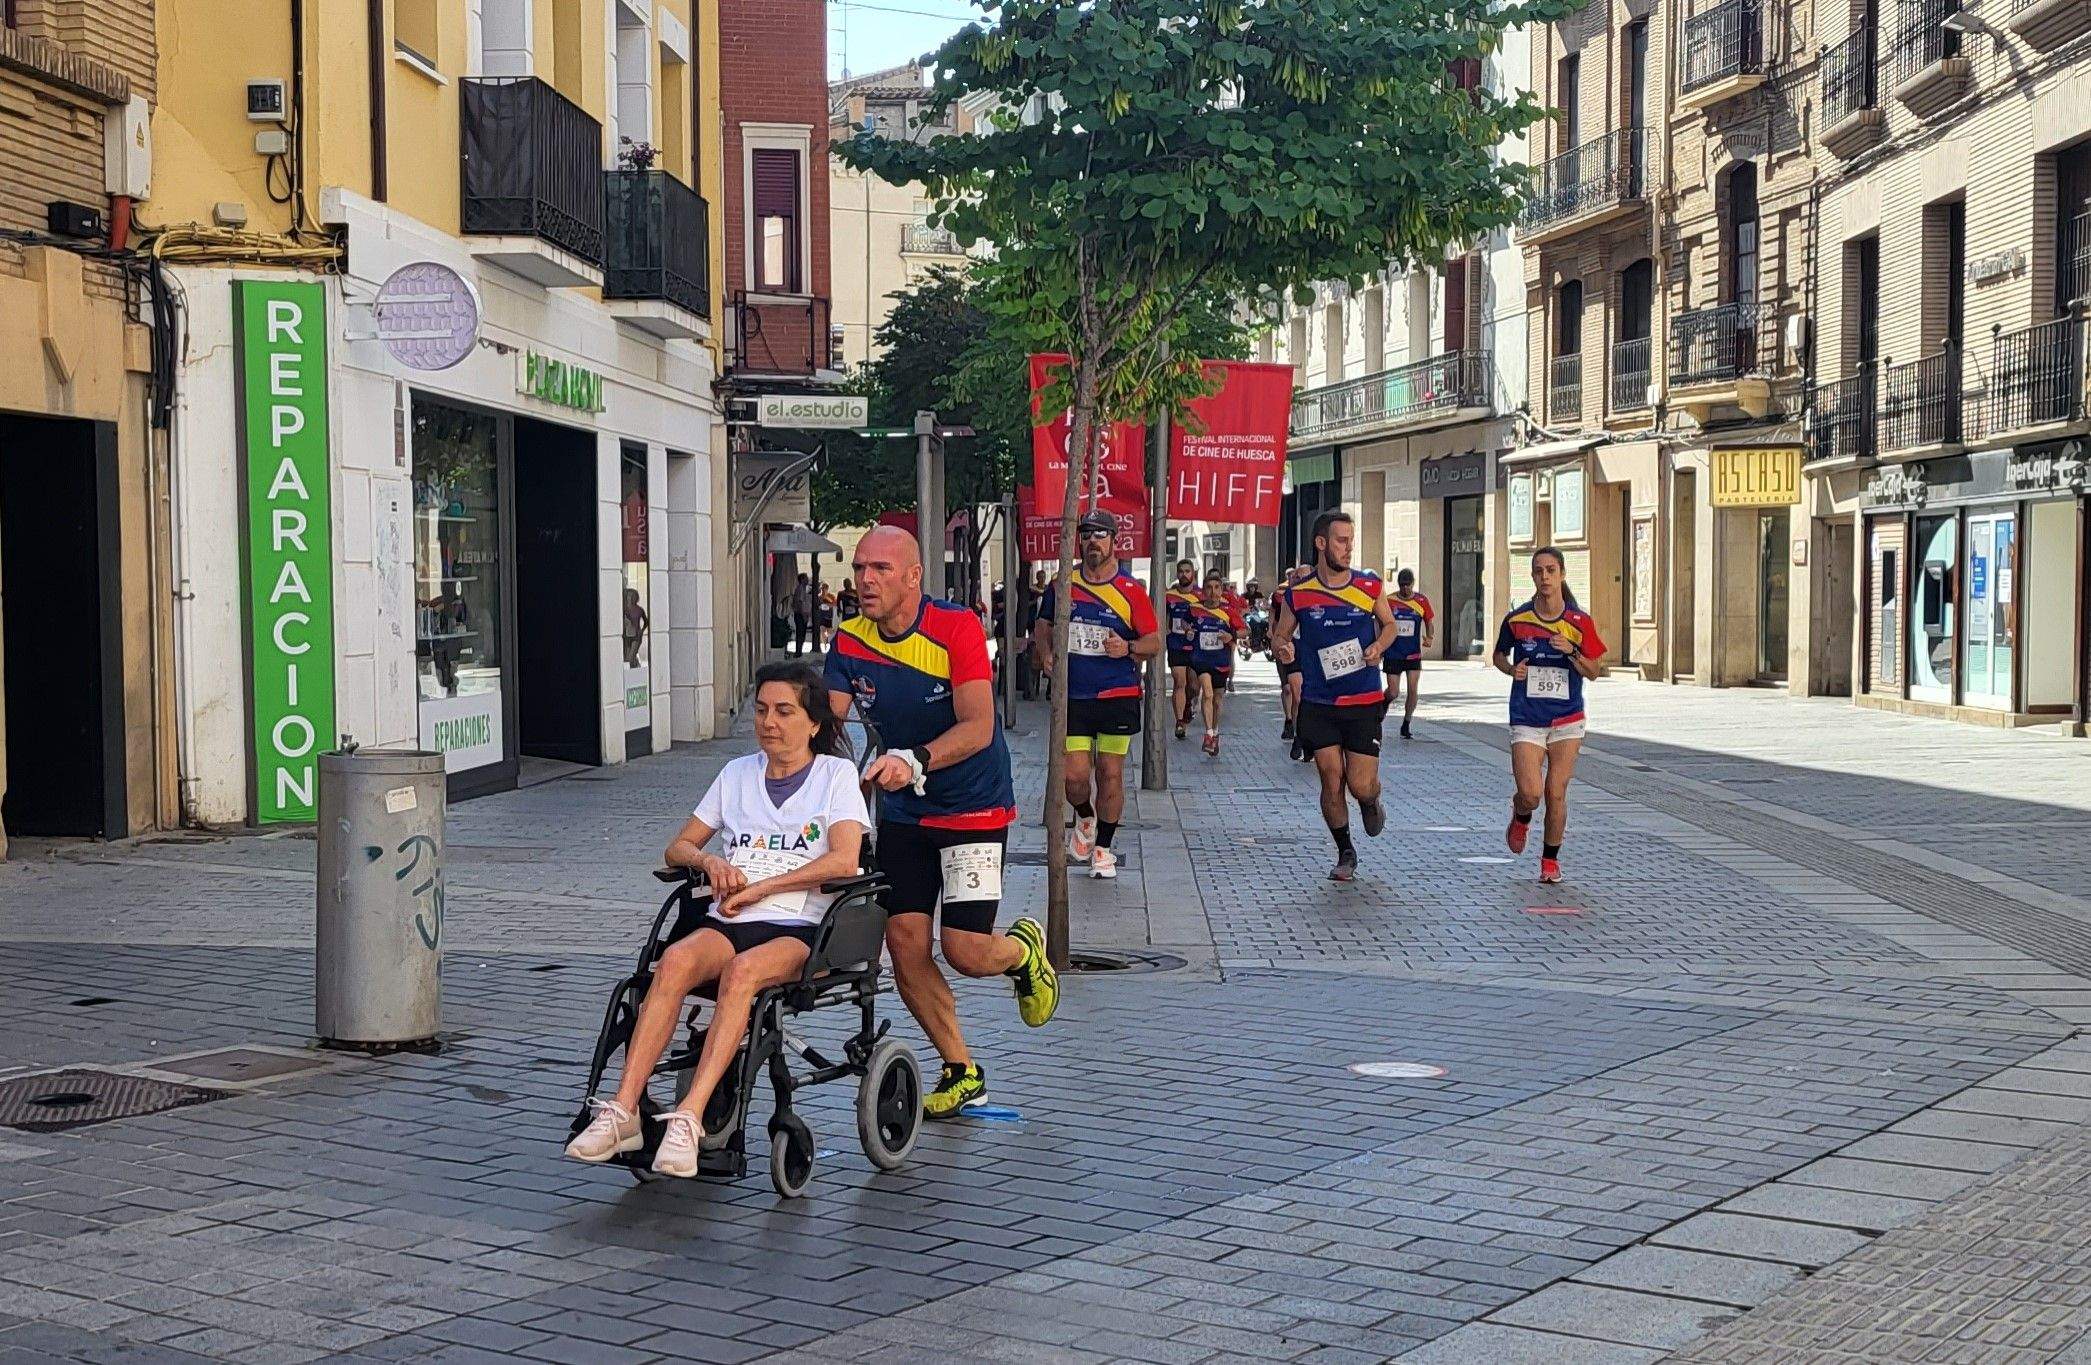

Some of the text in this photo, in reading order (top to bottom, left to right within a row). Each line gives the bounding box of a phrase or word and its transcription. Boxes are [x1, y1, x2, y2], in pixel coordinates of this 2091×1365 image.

[767, 399, 863, 418] el.estudio
[1183, 435, 1276, 444] FESTIVAL INTERNACIONAL
[1183, 446, 1276, 461] DE CINE DE HUESCA
[1718, 452, 1794, 493] ASCASO
[1179, 470, 1275, 509] HIFF
[267, 300, 315, 808] REPARACION
[1076, 639, 1100, 650] 129
[1332, 656, 1357, 671] 598
[1537, 681, 1562, 692] 597
[434, 713, 491, 754] REPARACIONES
[729, 832, 809, 851] ARAELA
[966, 871, 981, 889] 3
